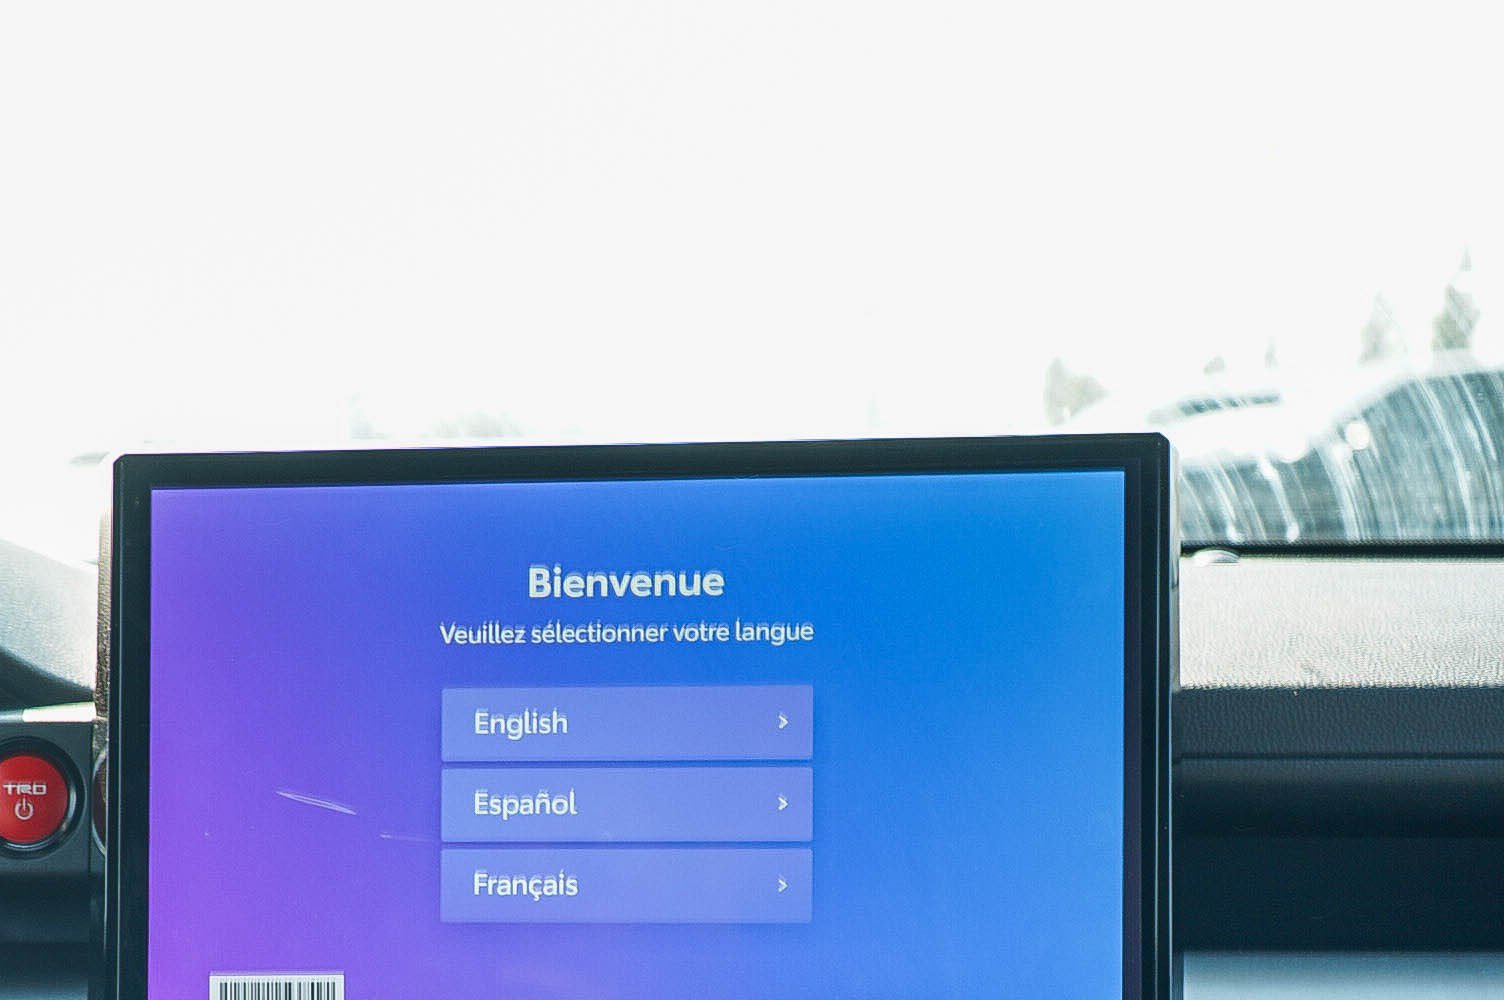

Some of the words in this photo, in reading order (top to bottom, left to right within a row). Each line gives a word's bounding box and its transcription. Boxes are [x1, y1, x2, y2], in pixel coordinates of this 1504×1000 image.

[528, 563, 726, 598] Bienvenue
[439, 621, 526, 645] Veuillez
[531, 619, 668, 644] sélectionner
[672, 622, 730, 643] votre
[735, 618, 815, 647] langue
[474, 708, 569, 741] English
[2, 783, 47, 796] TRD
[474, 788, 578, 820] Español
[473, 869, 579, 901] Français
